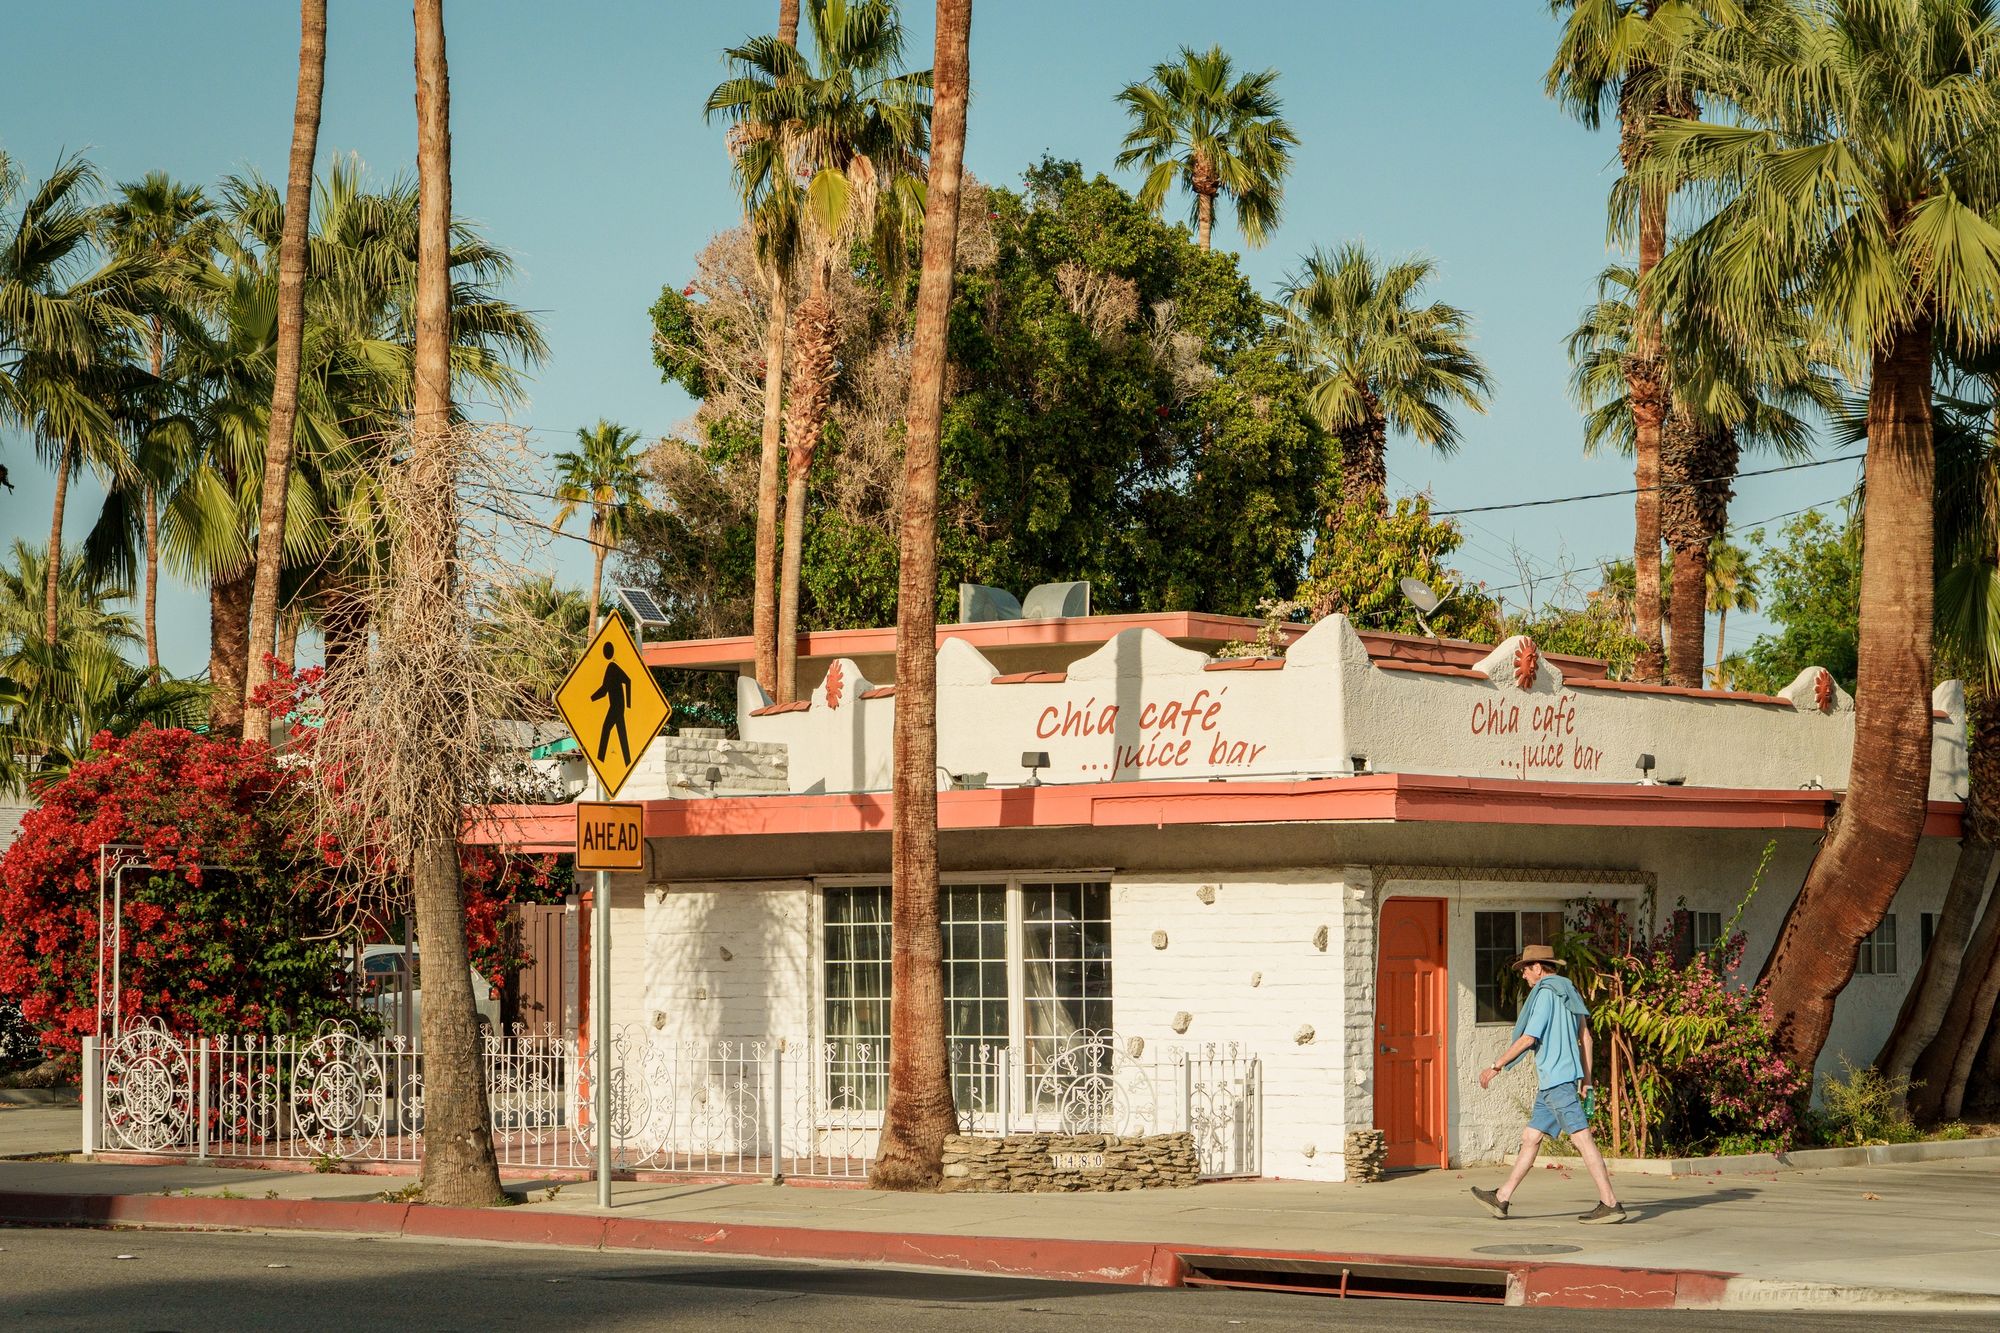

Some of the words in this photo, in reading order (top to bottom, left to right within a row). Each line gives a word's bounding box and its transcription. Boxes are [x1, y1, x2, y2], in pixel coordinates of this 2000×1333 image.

[1139, 686, 1228, 736] café
[1532, 693, 1577, 737] café
[1208, 731, 1266, 767] bar
[1574, 737, 1603, 771] bar
[583, 822, 638, 851] AHEAD
[1055, 1155, 1102, 1167] 1480
